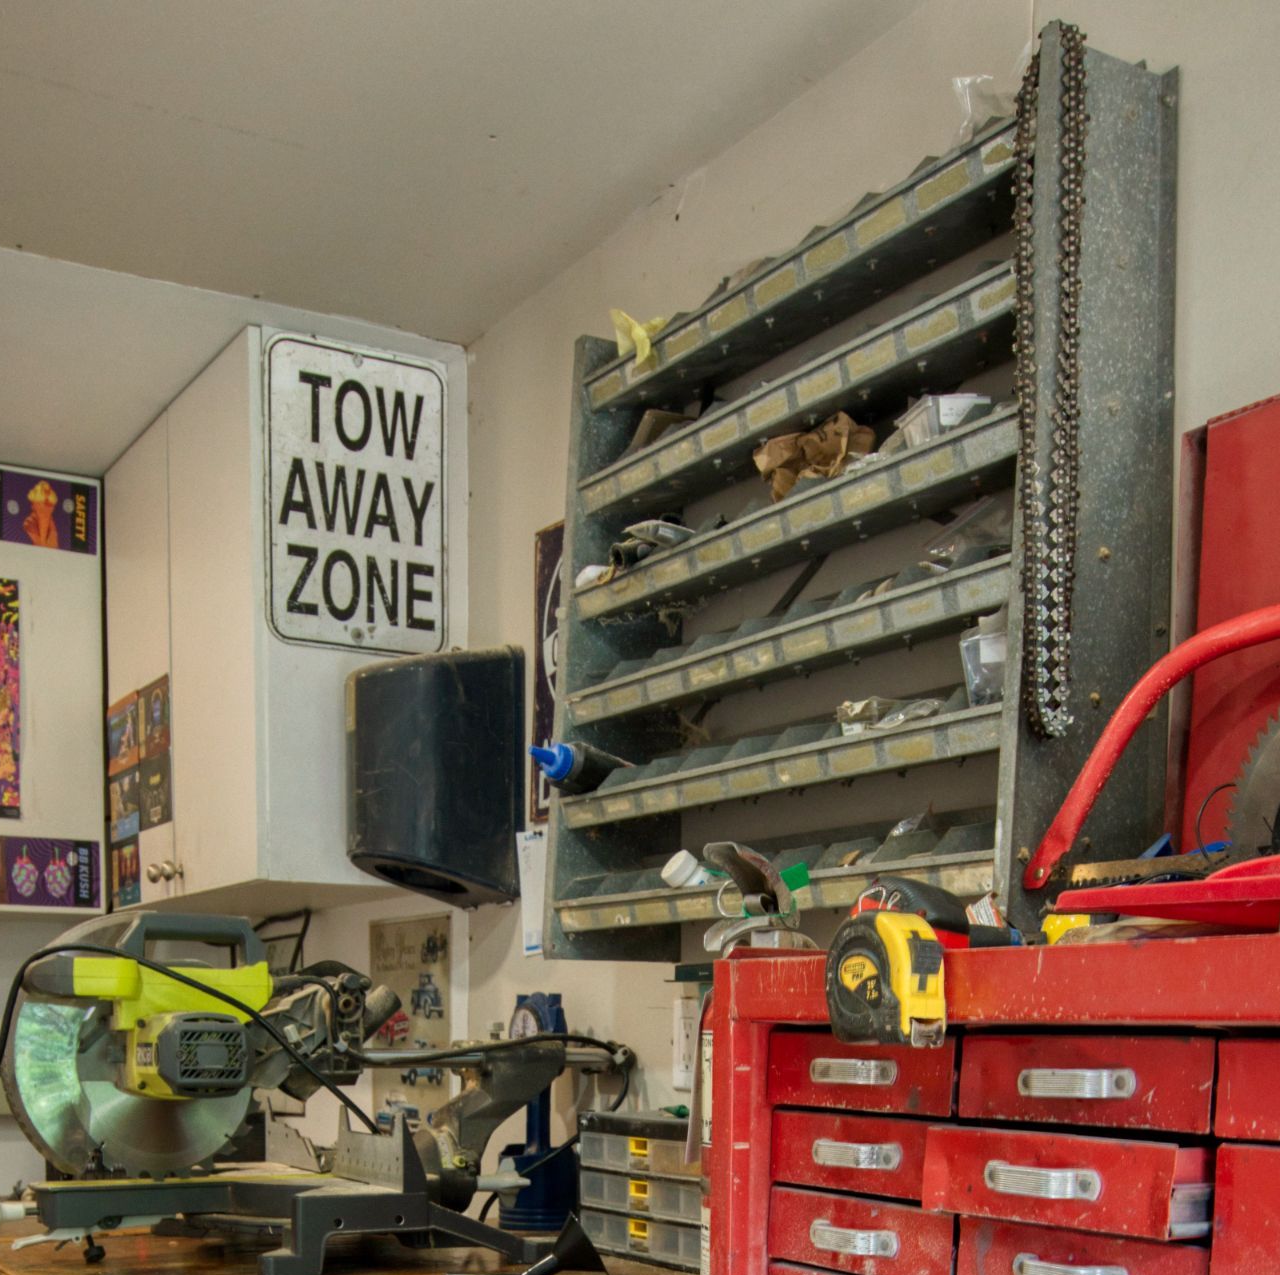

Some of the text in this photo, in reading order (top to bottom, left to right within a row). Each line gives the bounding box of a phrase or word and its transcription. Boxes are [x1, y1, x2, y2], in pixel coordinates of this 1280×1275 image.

[298, 370, 424, 461] TOW
[75, 494, 86, 542] SAFETY
[279, 457, 435, 547] AWAY
[286, 543, 435, 632] ZONE
[78, 864, 90, 899] KUSH
